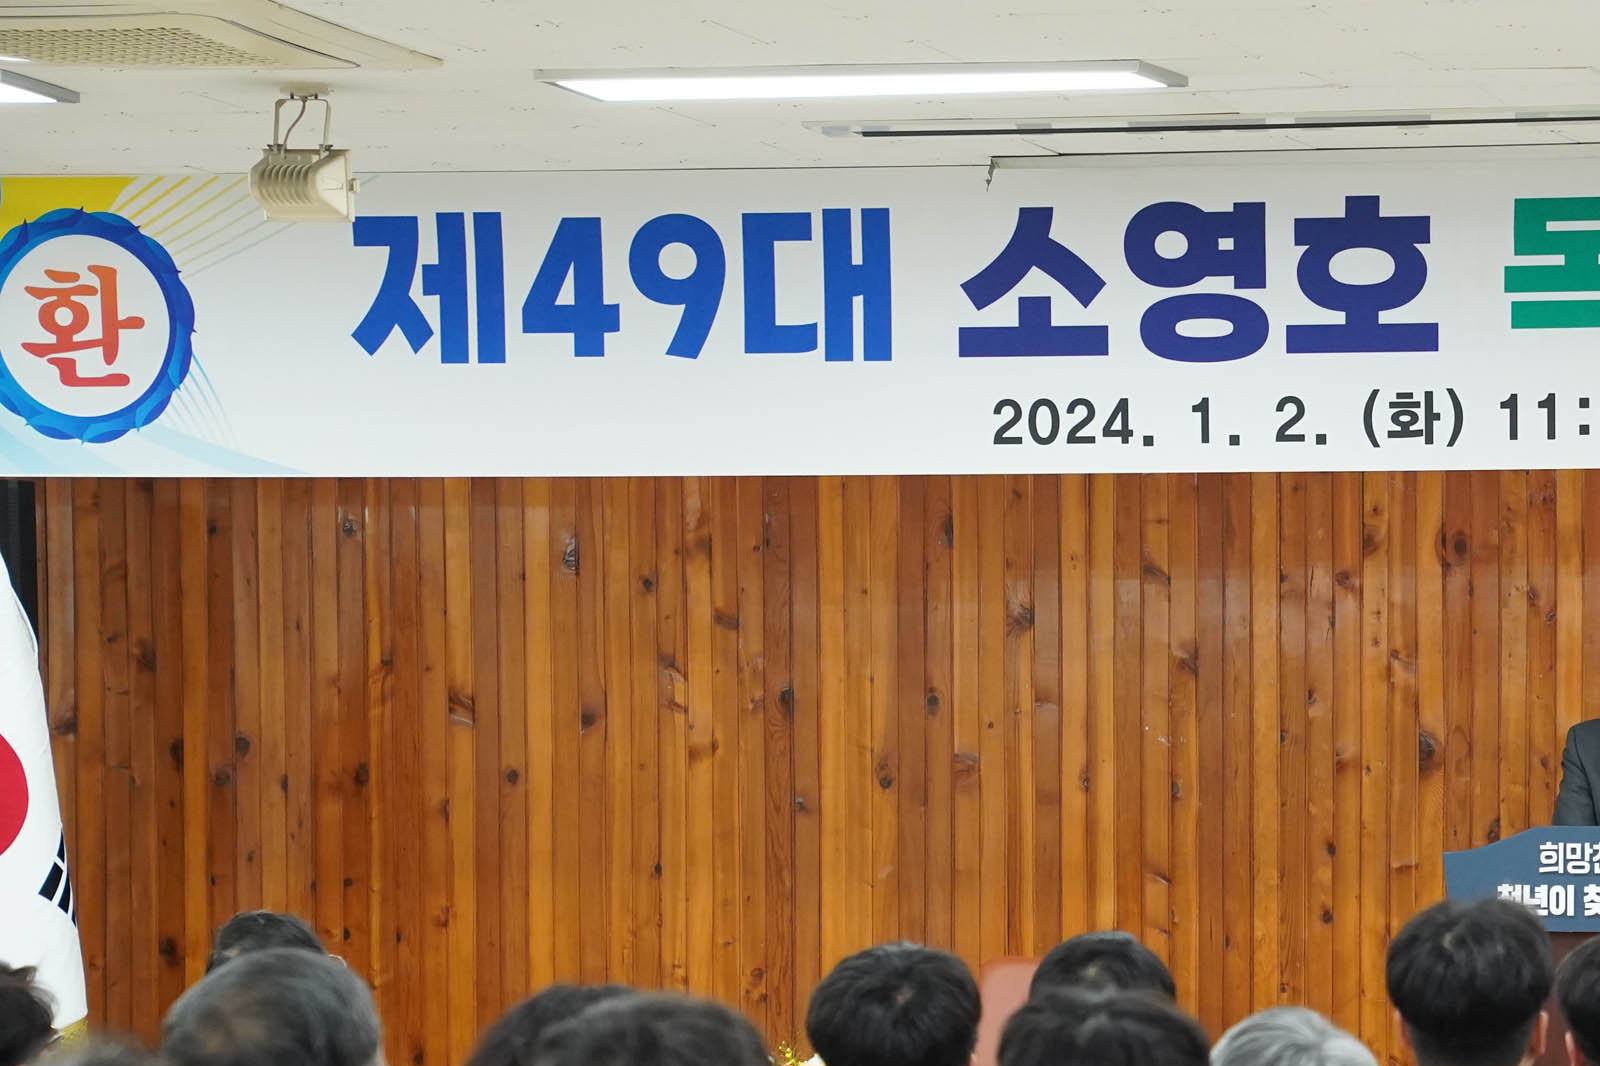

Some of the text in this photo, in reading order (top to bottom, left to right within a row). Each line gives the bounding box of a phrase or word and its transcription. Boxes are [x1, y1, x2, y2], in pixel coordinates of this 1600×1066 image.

[22, 264, 146, 388] 환
[351, 207, 893, 364] 제49대
[958, 195, 1439, 362] 소영호
[993, 397, 1155, 447] 2024.
[1191, 397, 1241, 446] 1.
[1275, 395, 1328, 446] 2.
[1362, 388, 1464, 448] (화)
